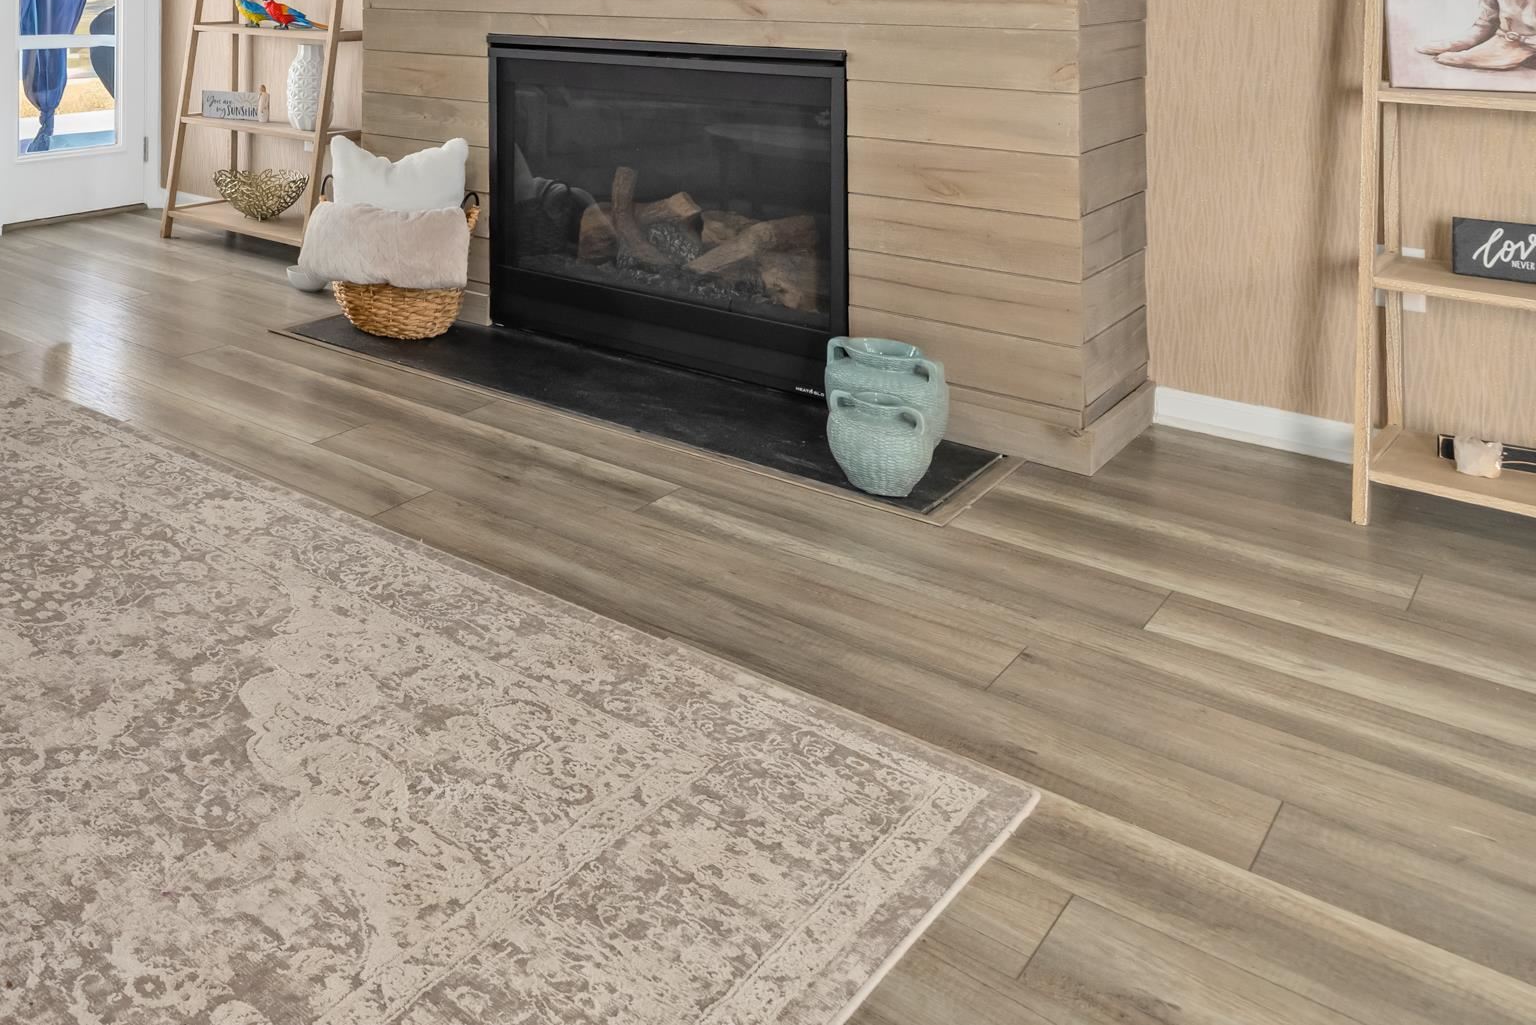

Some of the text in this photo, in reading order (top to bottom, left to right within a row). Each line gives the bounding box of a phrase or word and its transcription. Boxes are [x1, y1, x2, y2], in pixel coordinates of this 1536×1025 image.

[227, 105, 258, 118] SUNSHIN
[1472, 227, 1536, 268] lov
[1511, 260, 1536, 271] NEVER
